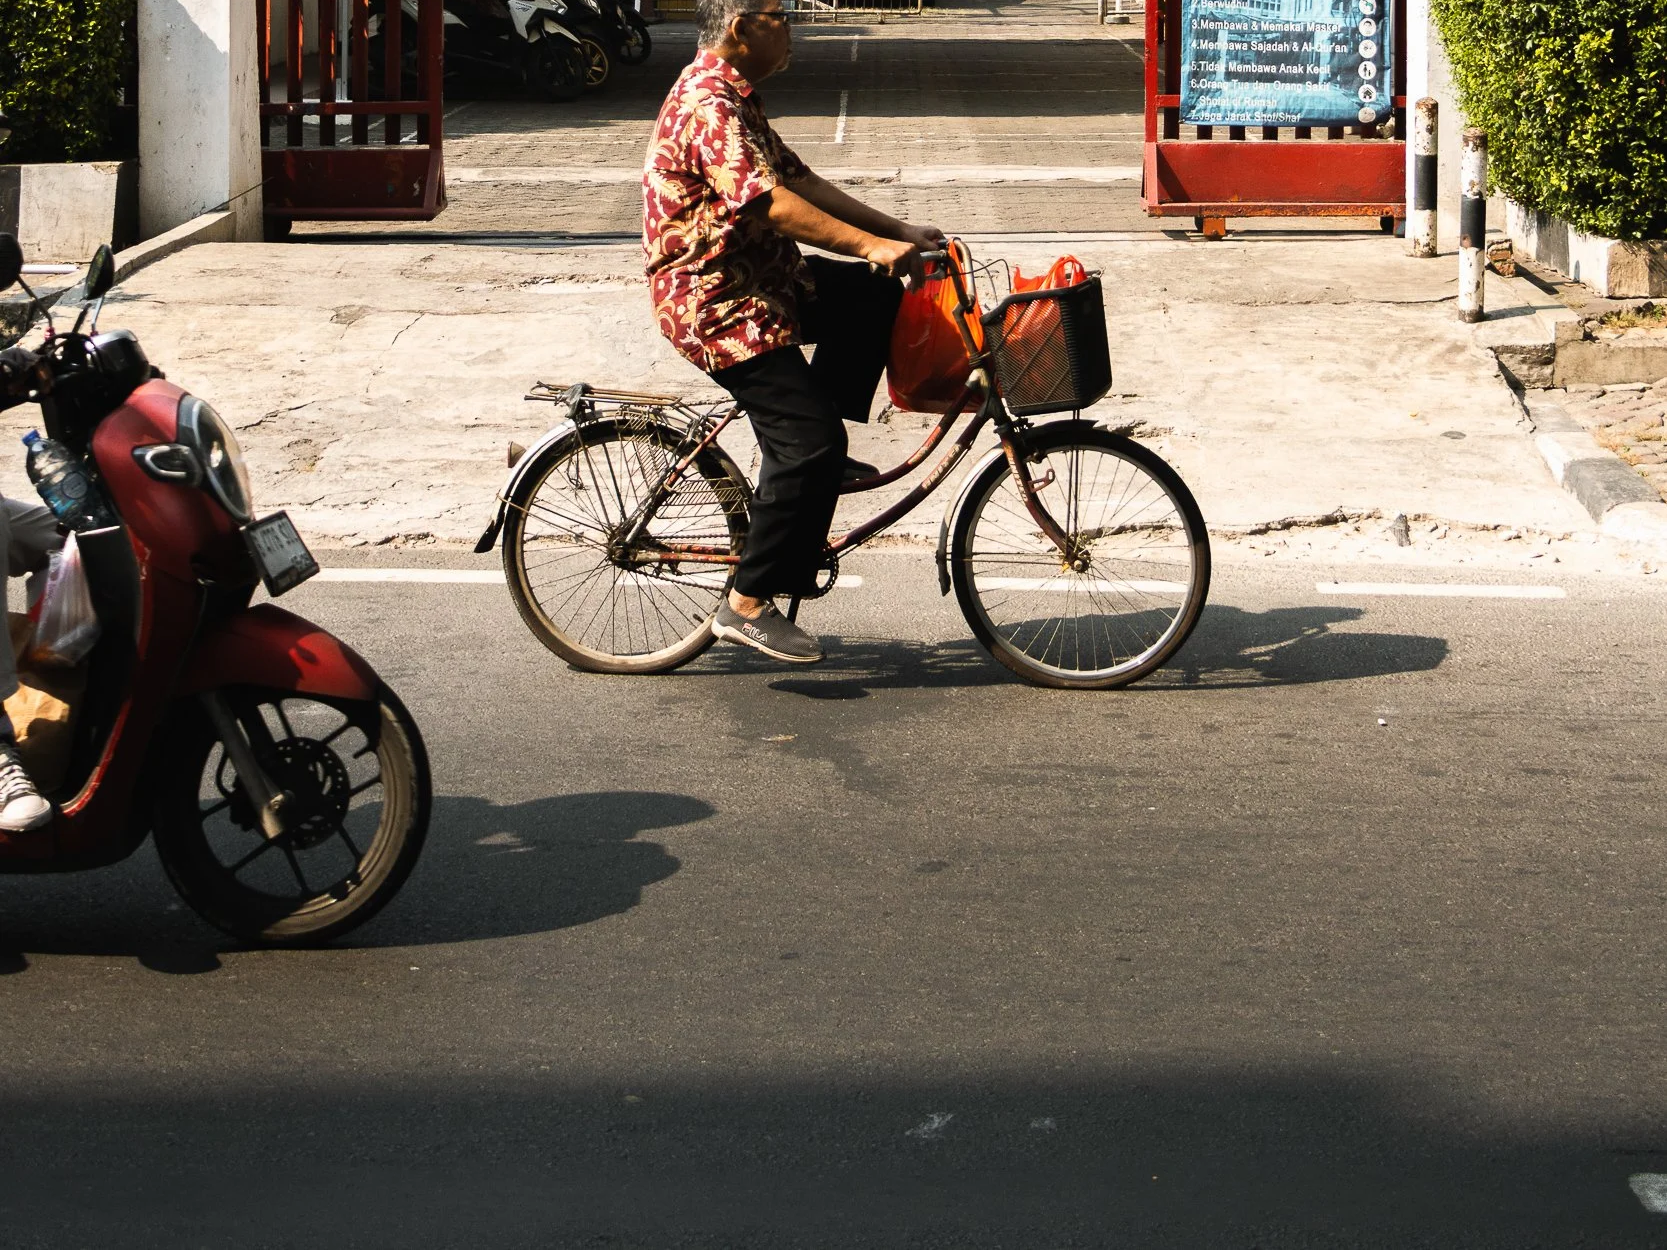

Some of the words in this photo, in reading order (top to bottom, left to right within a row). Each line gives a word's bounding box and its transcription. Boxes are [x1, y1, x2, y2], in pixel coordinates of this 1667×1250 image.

[1251, 21, 1258, 30] &
[1260, 20, 1304, 32] Memakai
[1306, 22, 1341, 33] Masker
[1250, 40, 1290, 53] Sajadah
[1292, 41, 1299, 51] &
[1301, 41, 1347, 53] Al-Qur'an
[1228, 62, 1277, 73] Membawa
[1279, 63, 1304, 74] Anak
[1306, 64, 1330, 74] Kecil
[1231, 79, 1249, 90] Tua
[1252, 80, 1270, 90] dan
[1273, 80, 1303, 93] Orang
[1305, 81, 1331, 91] Sakit
[1199, 96, 1229, 106] Sholat
[1231, 97, 1238, 106] di
[1243, 97, 1277, 107] Rumah
[1224, 111, 1251, 121] Jarak
[741, 622, 768, 644] FILA
